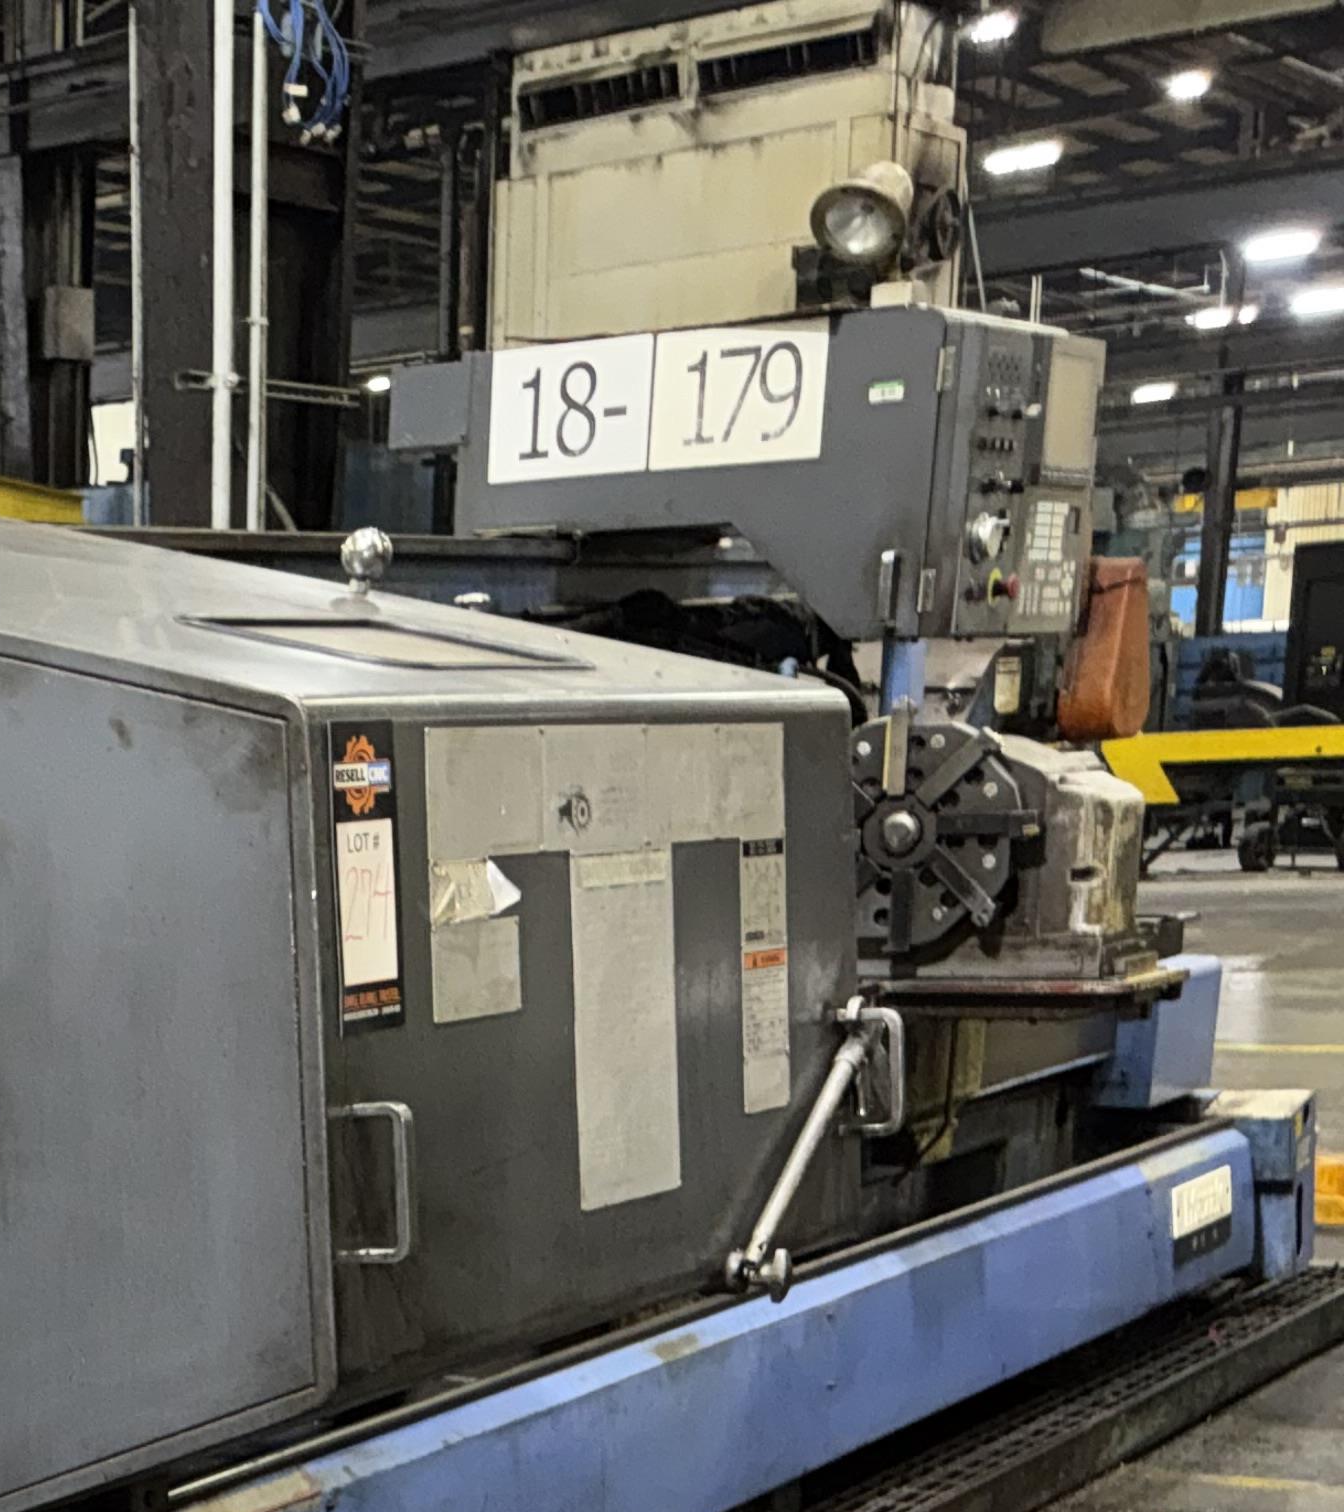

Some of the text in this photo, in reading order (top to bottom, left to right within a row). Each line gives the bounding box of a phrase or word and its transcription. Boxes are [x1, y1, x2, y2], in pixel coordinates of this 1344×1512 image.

[682, 340, 803, 447] 179
[335, 767, 367, 783] RESELL
[346, 833, 380, 853] LOT #
